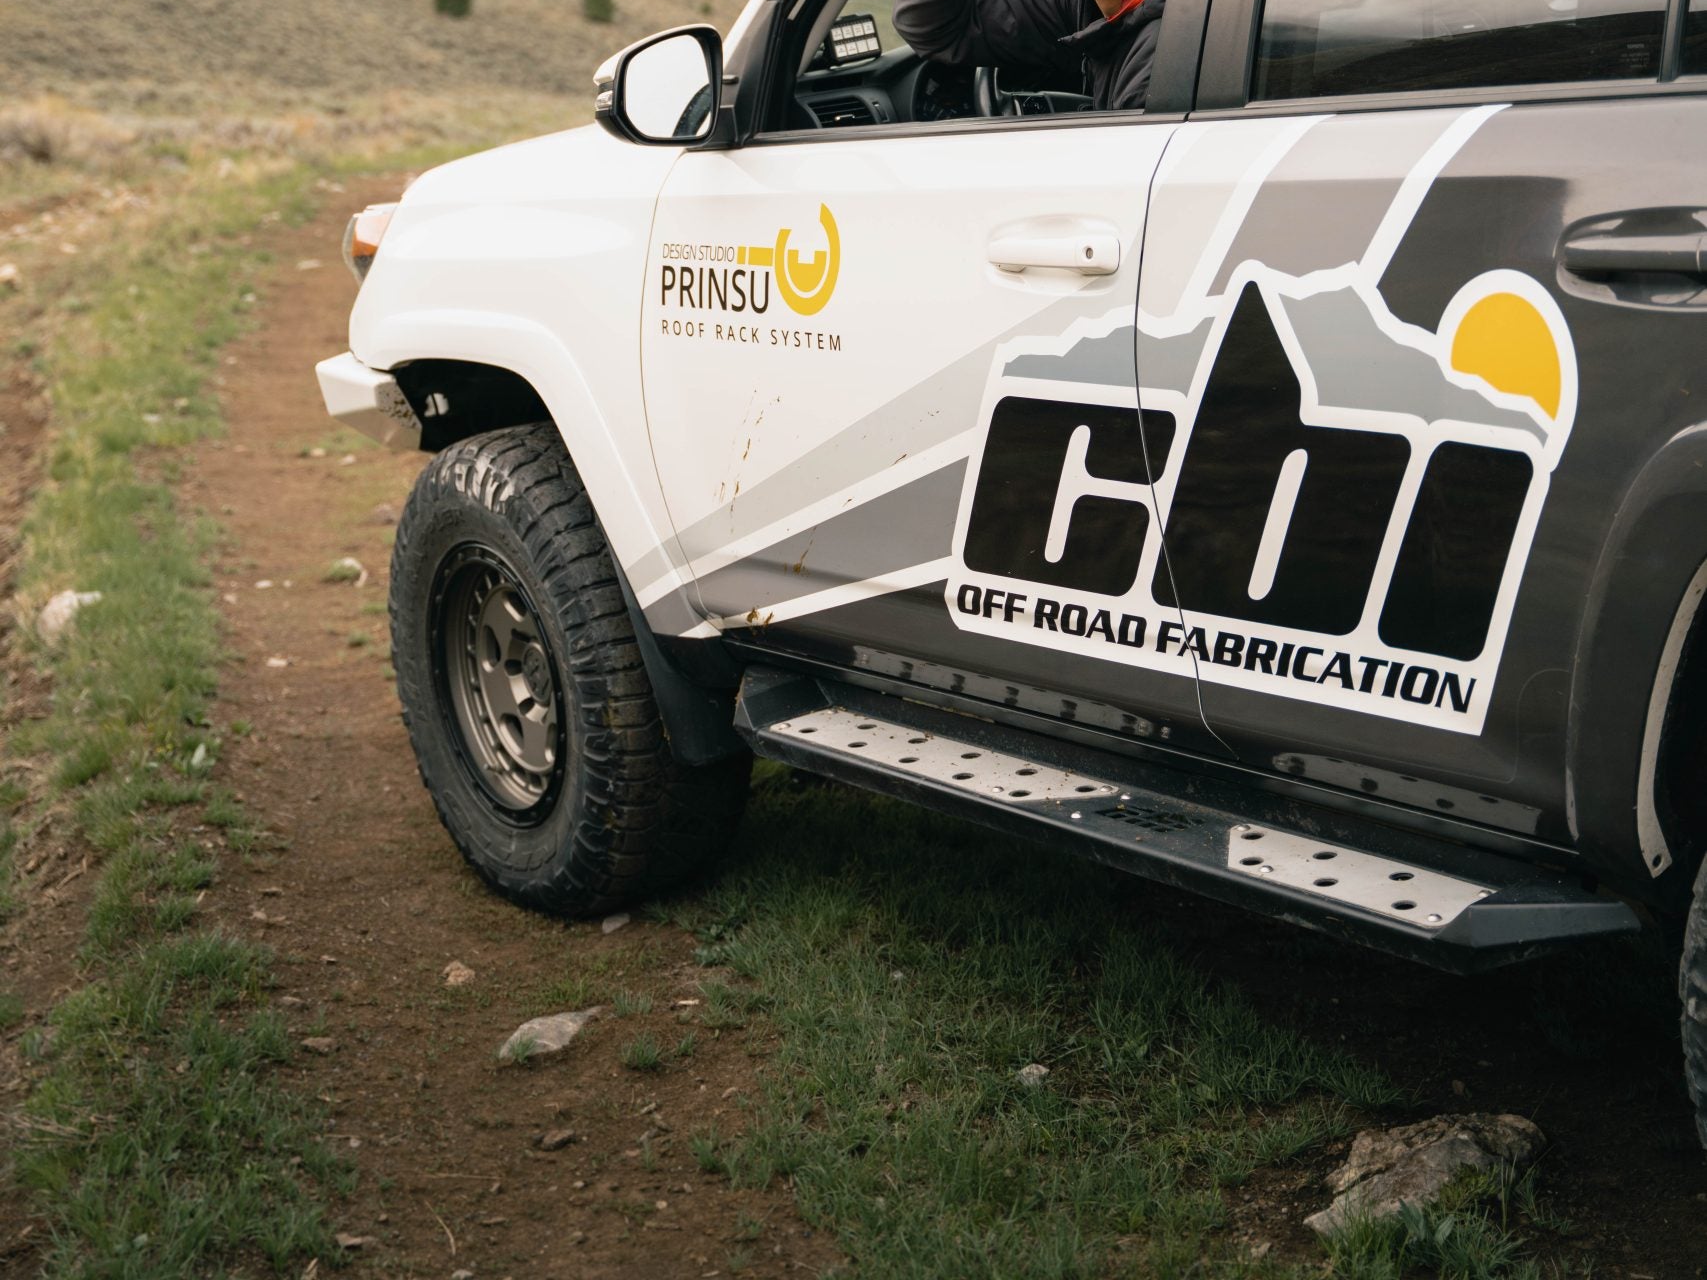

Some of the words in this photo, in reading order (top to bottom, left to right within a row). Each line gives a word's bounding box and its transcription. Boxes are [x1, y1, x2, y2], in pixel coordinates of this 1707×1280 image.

[662, 243, 697, 260] DESIGN
[698, 245, 735, 262] STUDIO
[661, 265, 770, 314] PRINSU
[661, 319, 705, 338] ROOF
[715, 324, 760, 344] RACK
[770, 329, 841, 351] SYSTEM
[956, 584, 1026, 623] OFF
[1033, 597, 1148, 650] ROAD
[1155, 621, 1477, 714] FABRICATION
